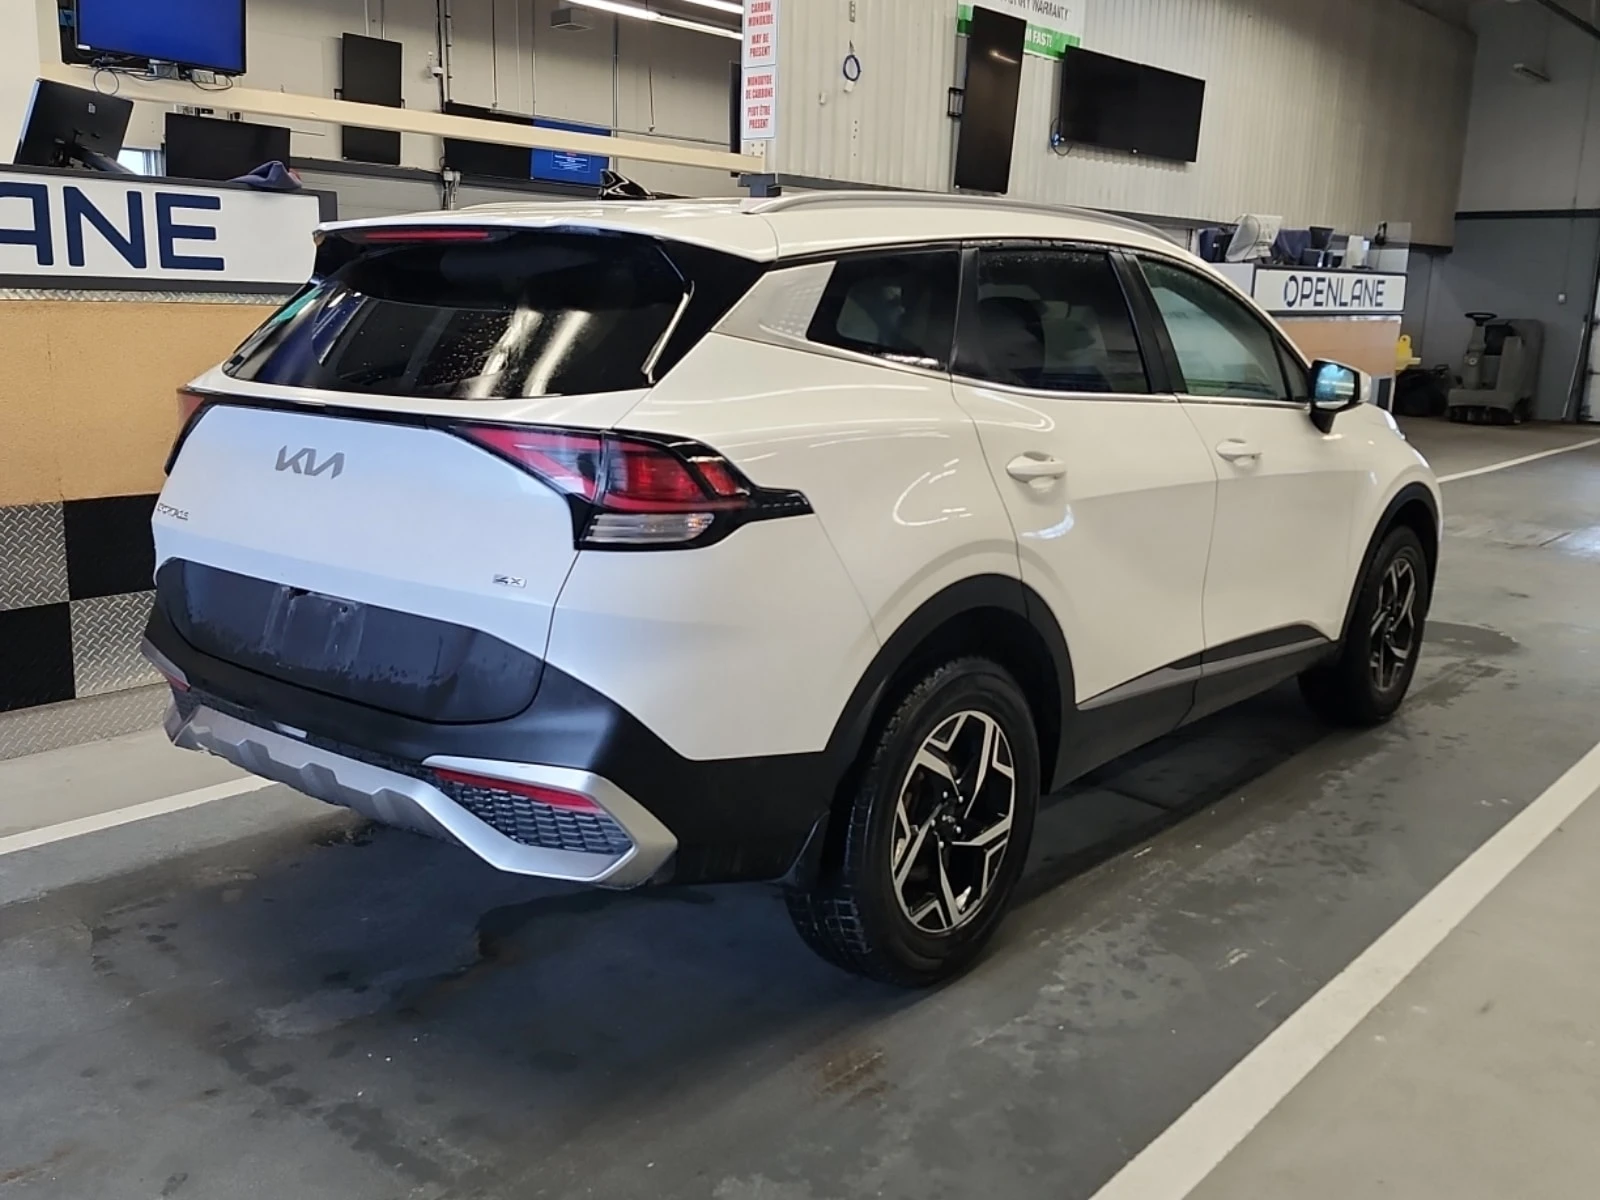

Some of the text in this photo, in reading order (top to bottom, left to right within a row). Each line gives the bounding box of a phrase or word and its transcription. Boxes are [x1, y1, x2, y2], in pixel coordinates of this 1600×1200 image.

[751, 1, 771, 13] CARBON
[1032, 0, 1069, 20] WARRANTY
[748, 14, 773, 26] MONOXIDE
[752, 33, 769, 44] MAY BE
[750, 46, 770, 57] PRESENT
[1284, 274, 1386, 307] OPENLANE
[275, 445, 345, 479] KIA
